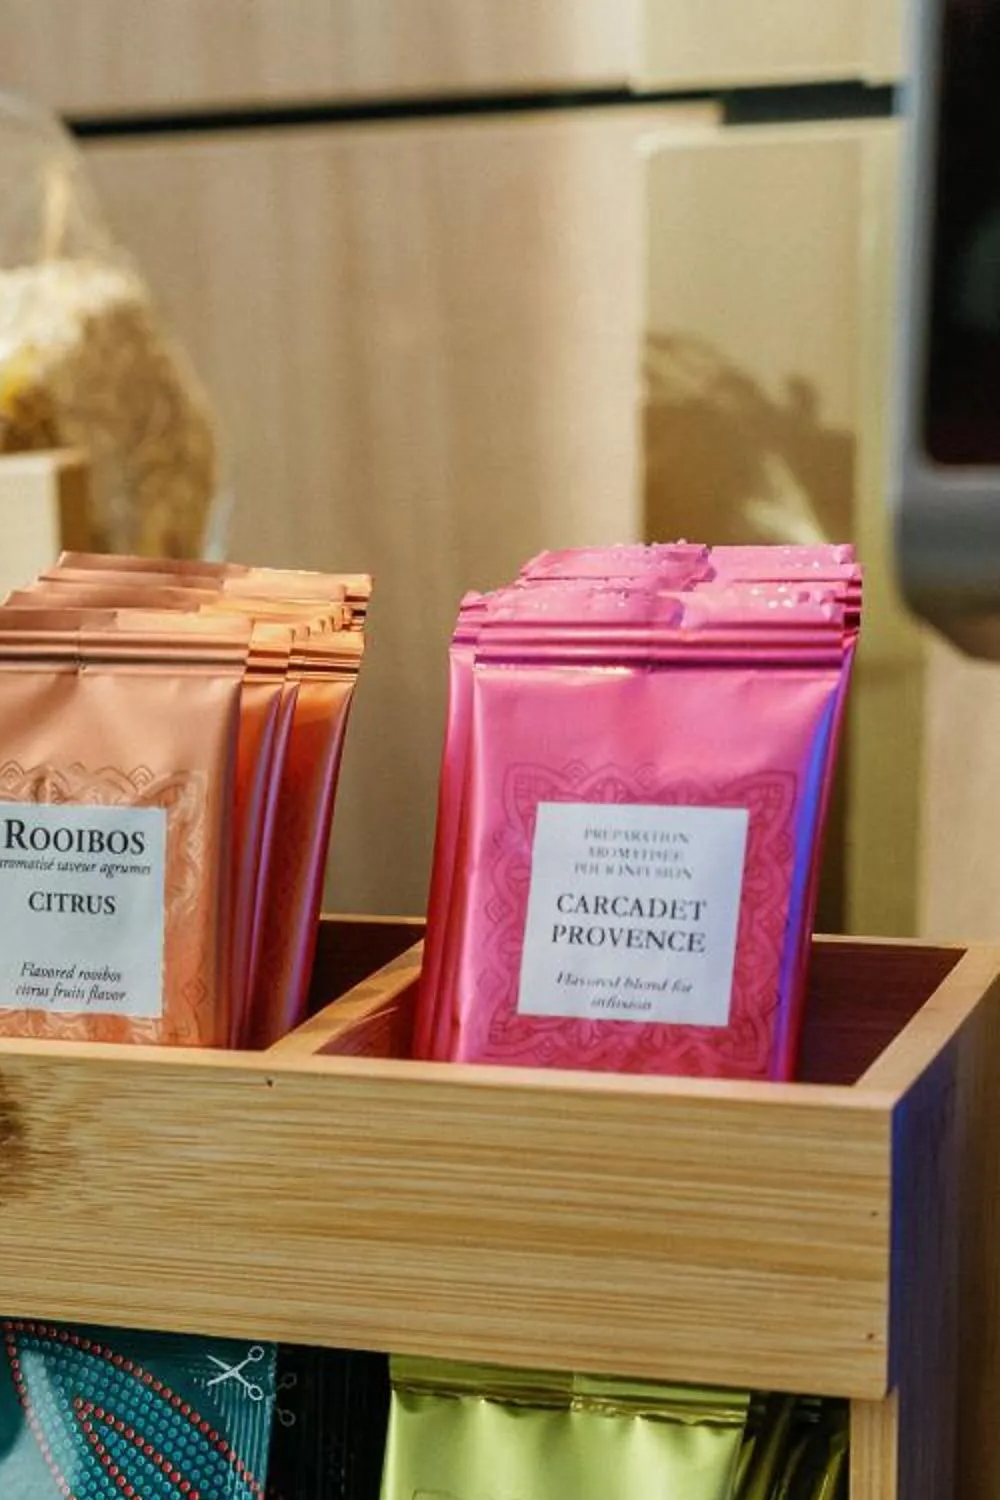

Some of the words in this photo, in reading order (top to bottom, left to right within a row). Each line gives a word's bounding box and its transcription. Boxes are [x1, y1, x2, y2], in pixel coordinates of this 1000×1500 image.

[57, 862, 97, 873] saveur
[99, 863, 152, 878] agrumes
[28, 891, 116, 915] CITRUS
[557, 893, 707, 921] CARCADET
[551, 924, 707, 953] PROVENCE
[21, 961, 76, 980] Flavored
[78, 964, 122, 982] rooibos
[15, 983, 49, 998] citrus
[50, 982, 85, 1002] fruits
[86, 985, 126, 1004] flavor
